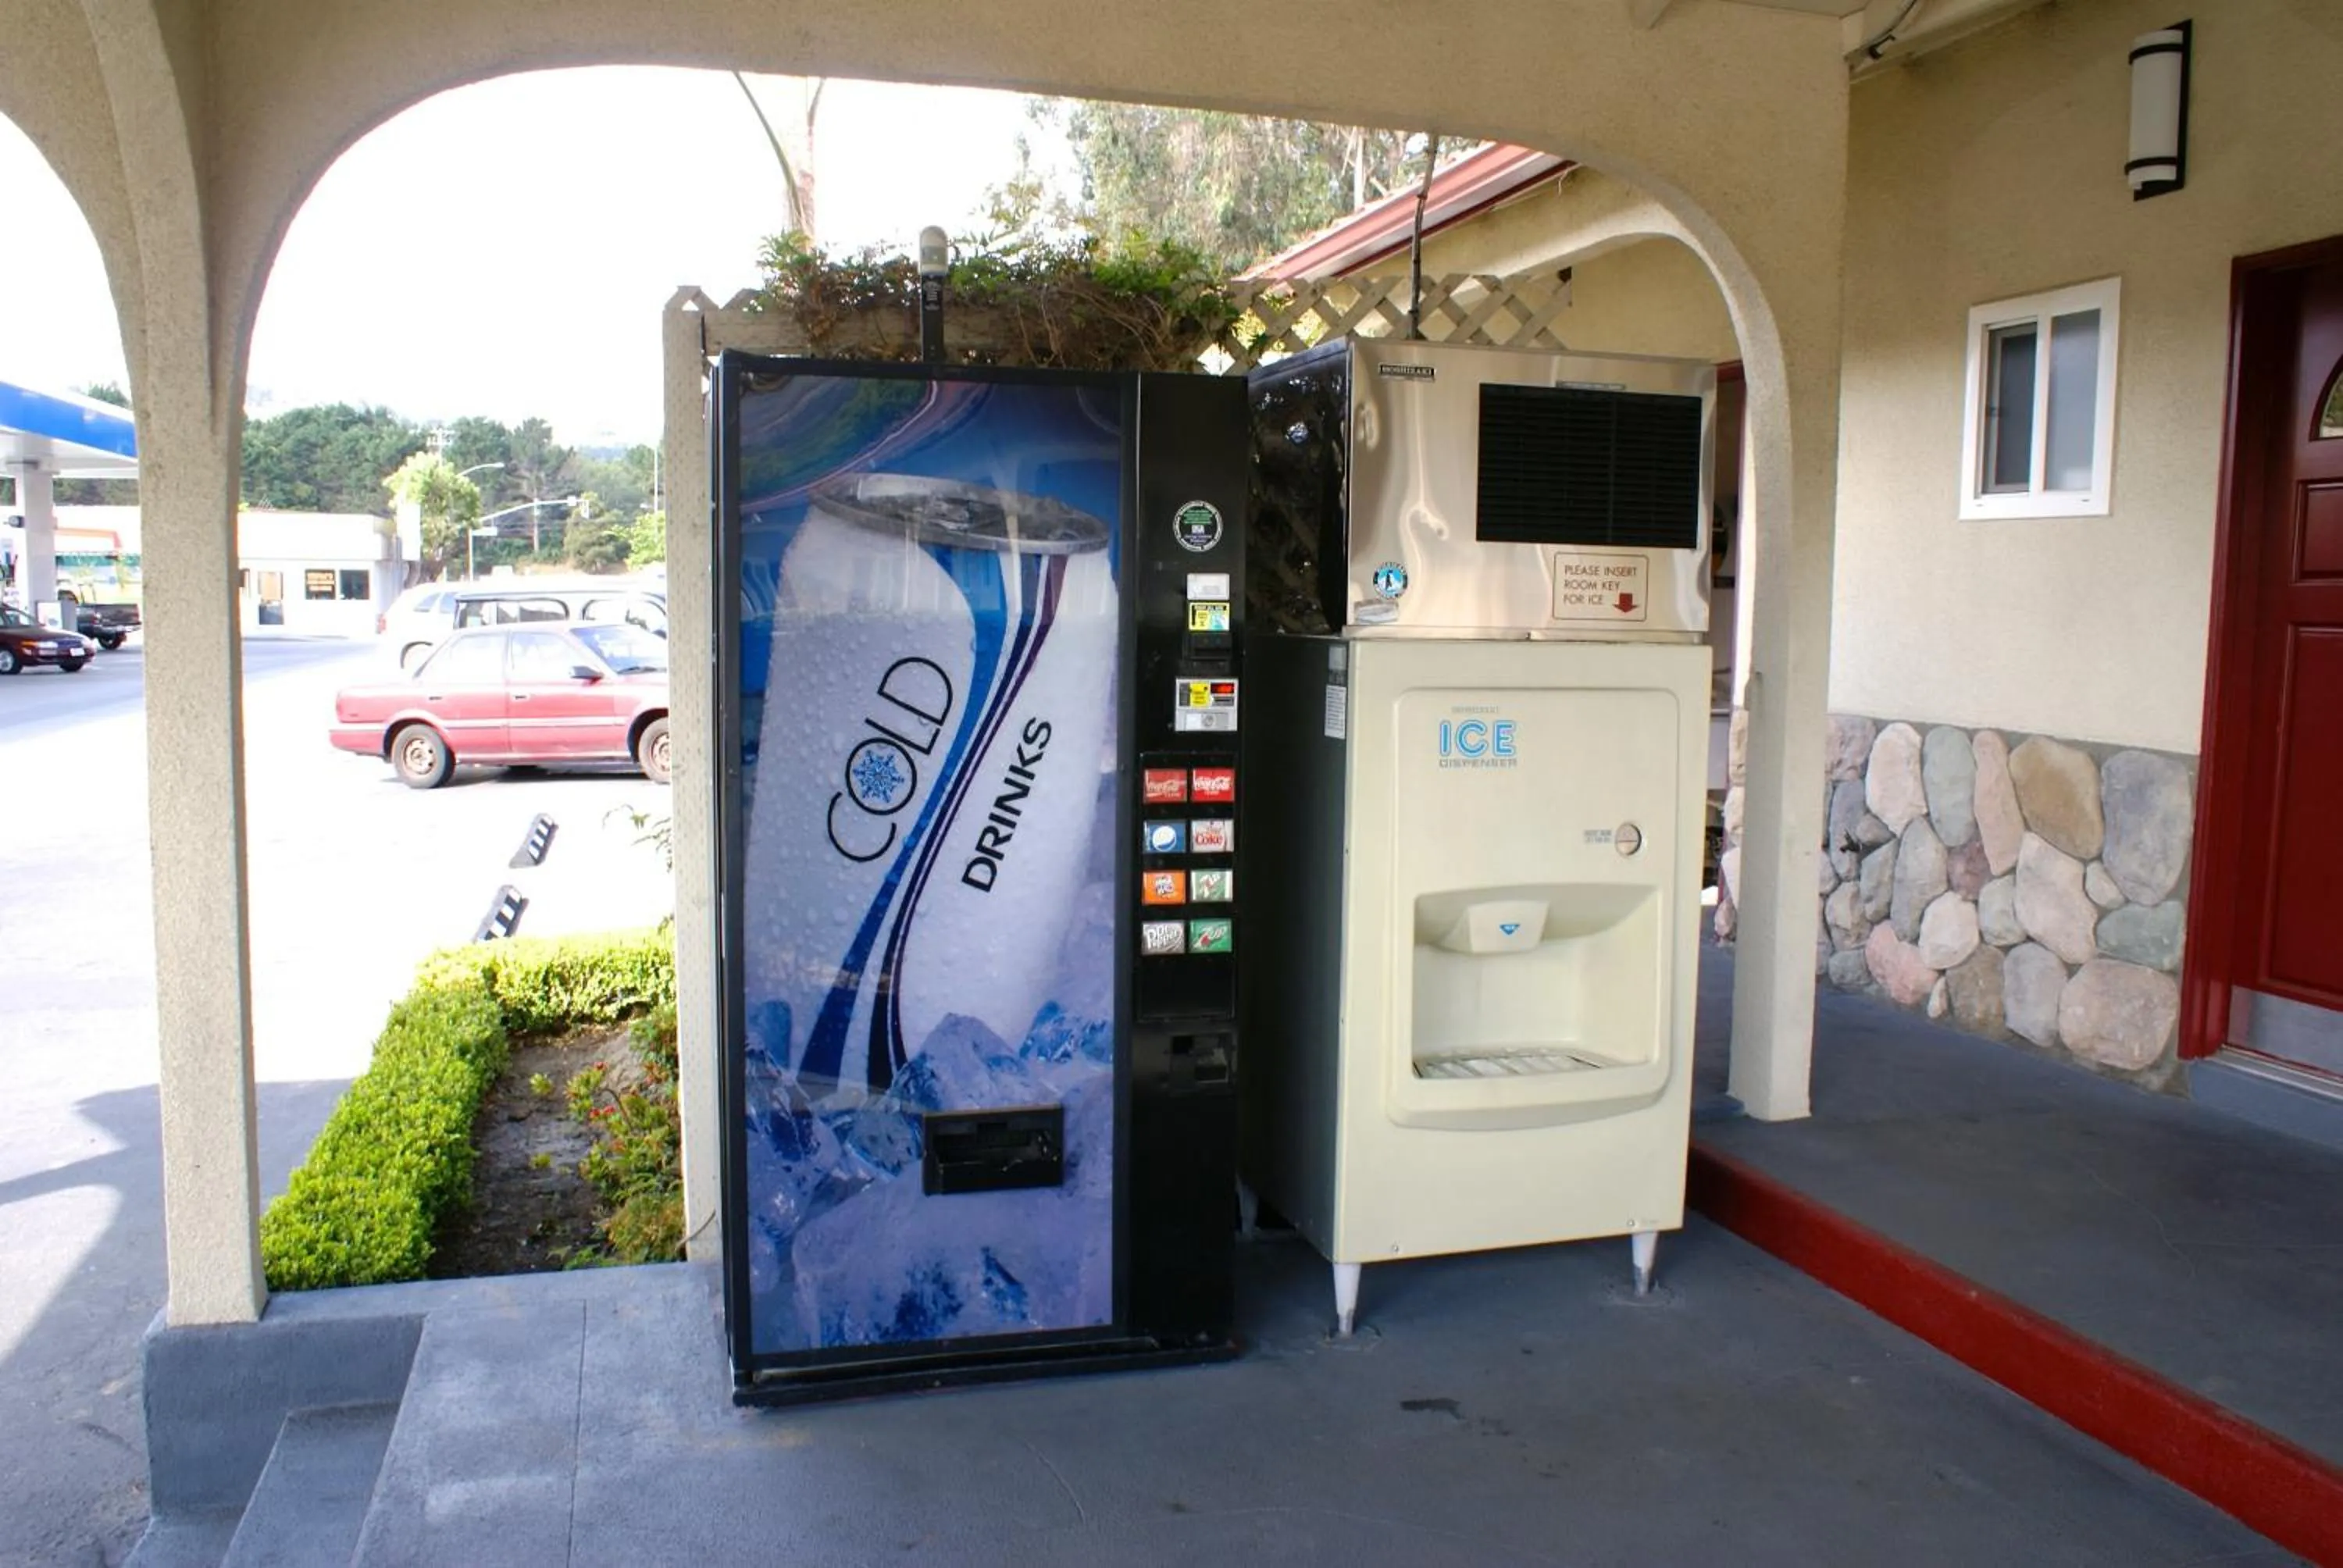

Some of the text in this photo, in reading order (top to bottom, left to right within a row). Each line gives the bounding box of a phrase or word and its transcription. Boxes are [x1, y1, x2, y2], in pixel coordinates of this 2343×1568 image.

[1564, 565, 1637, 577] PLEASE INSERT
[1564, 579, 1621, 591] ROOM KEY
[1564, 593, 1604, 605] FOR ICE
[1439, 719, 1517, 757] ICE
[827, 657, 953, 862] COLD
[1439, 758, 1517, 768] DISPENSER
[961, 717, 1052, 893] DRINKS
